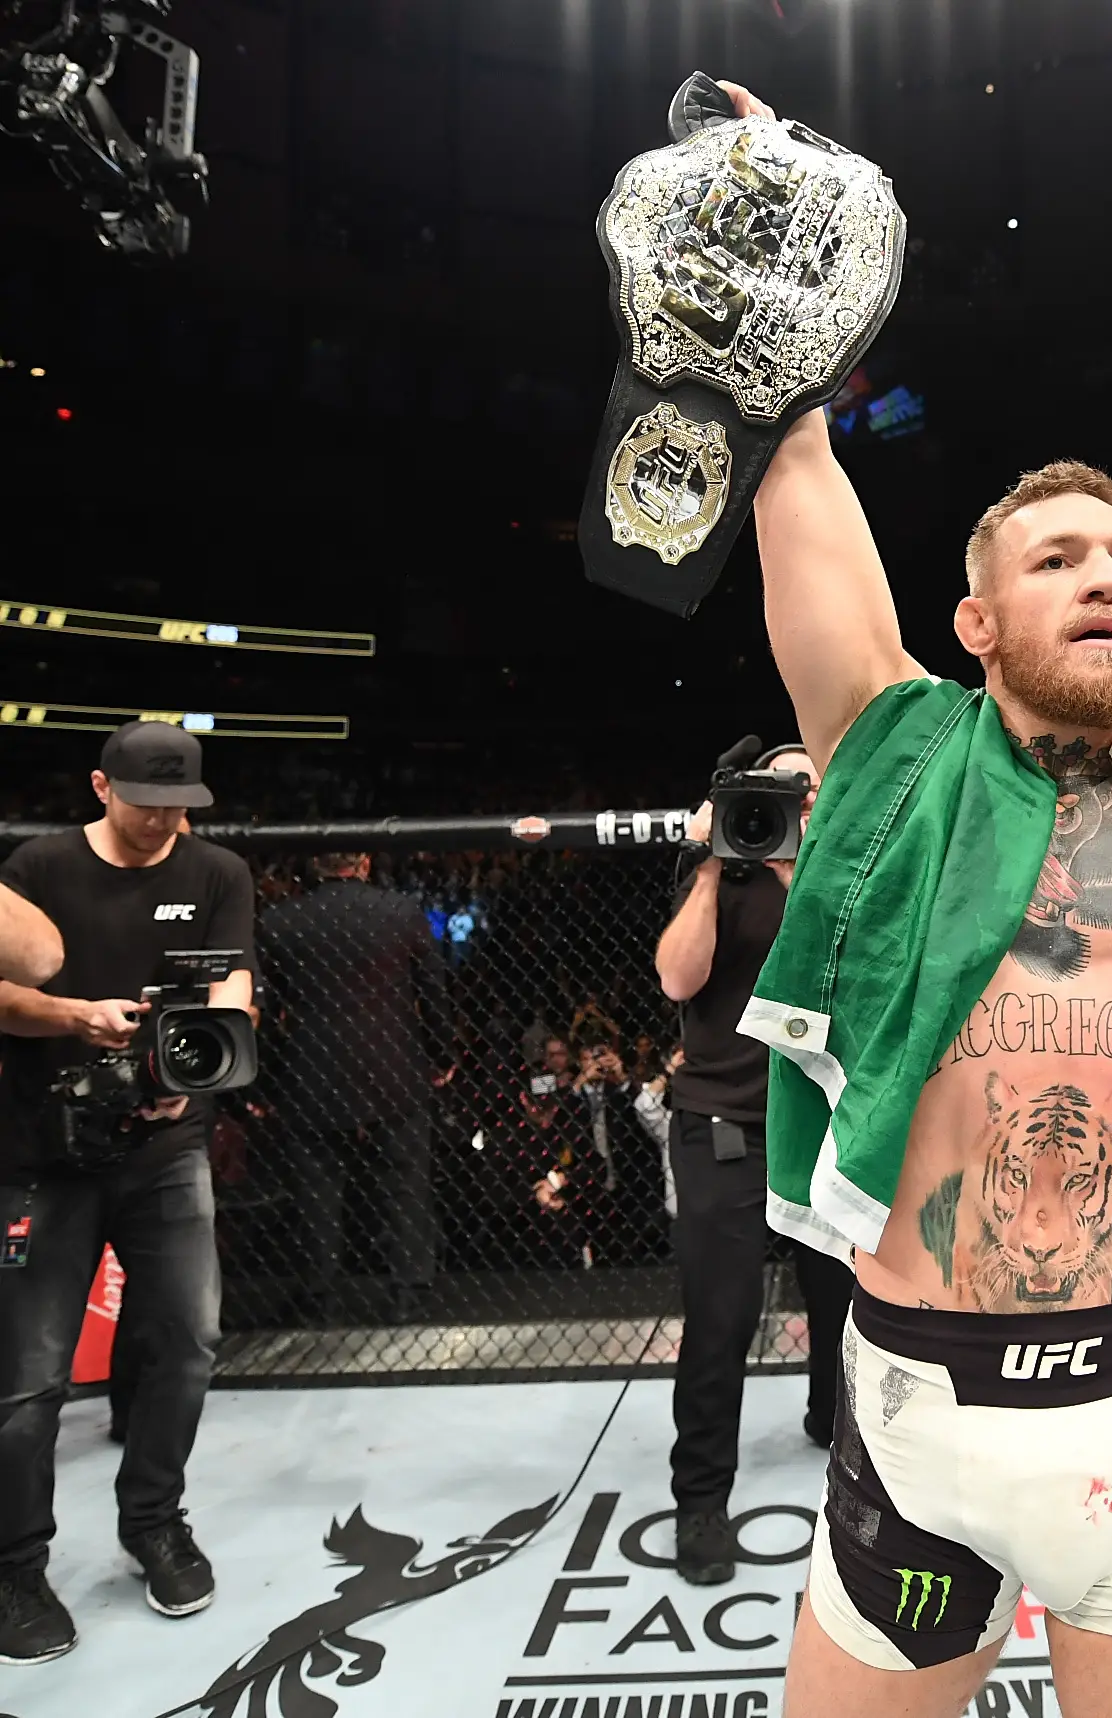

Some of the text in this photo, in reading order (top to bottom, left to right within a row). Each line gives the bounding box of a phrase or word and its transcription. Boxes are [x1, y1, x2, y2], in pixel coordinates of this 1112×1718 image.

[153, 904, 197, 921] UFC
[1000, 1337, 1103, 1380] UFC
[522, 1575, 804, 1658] FAC
